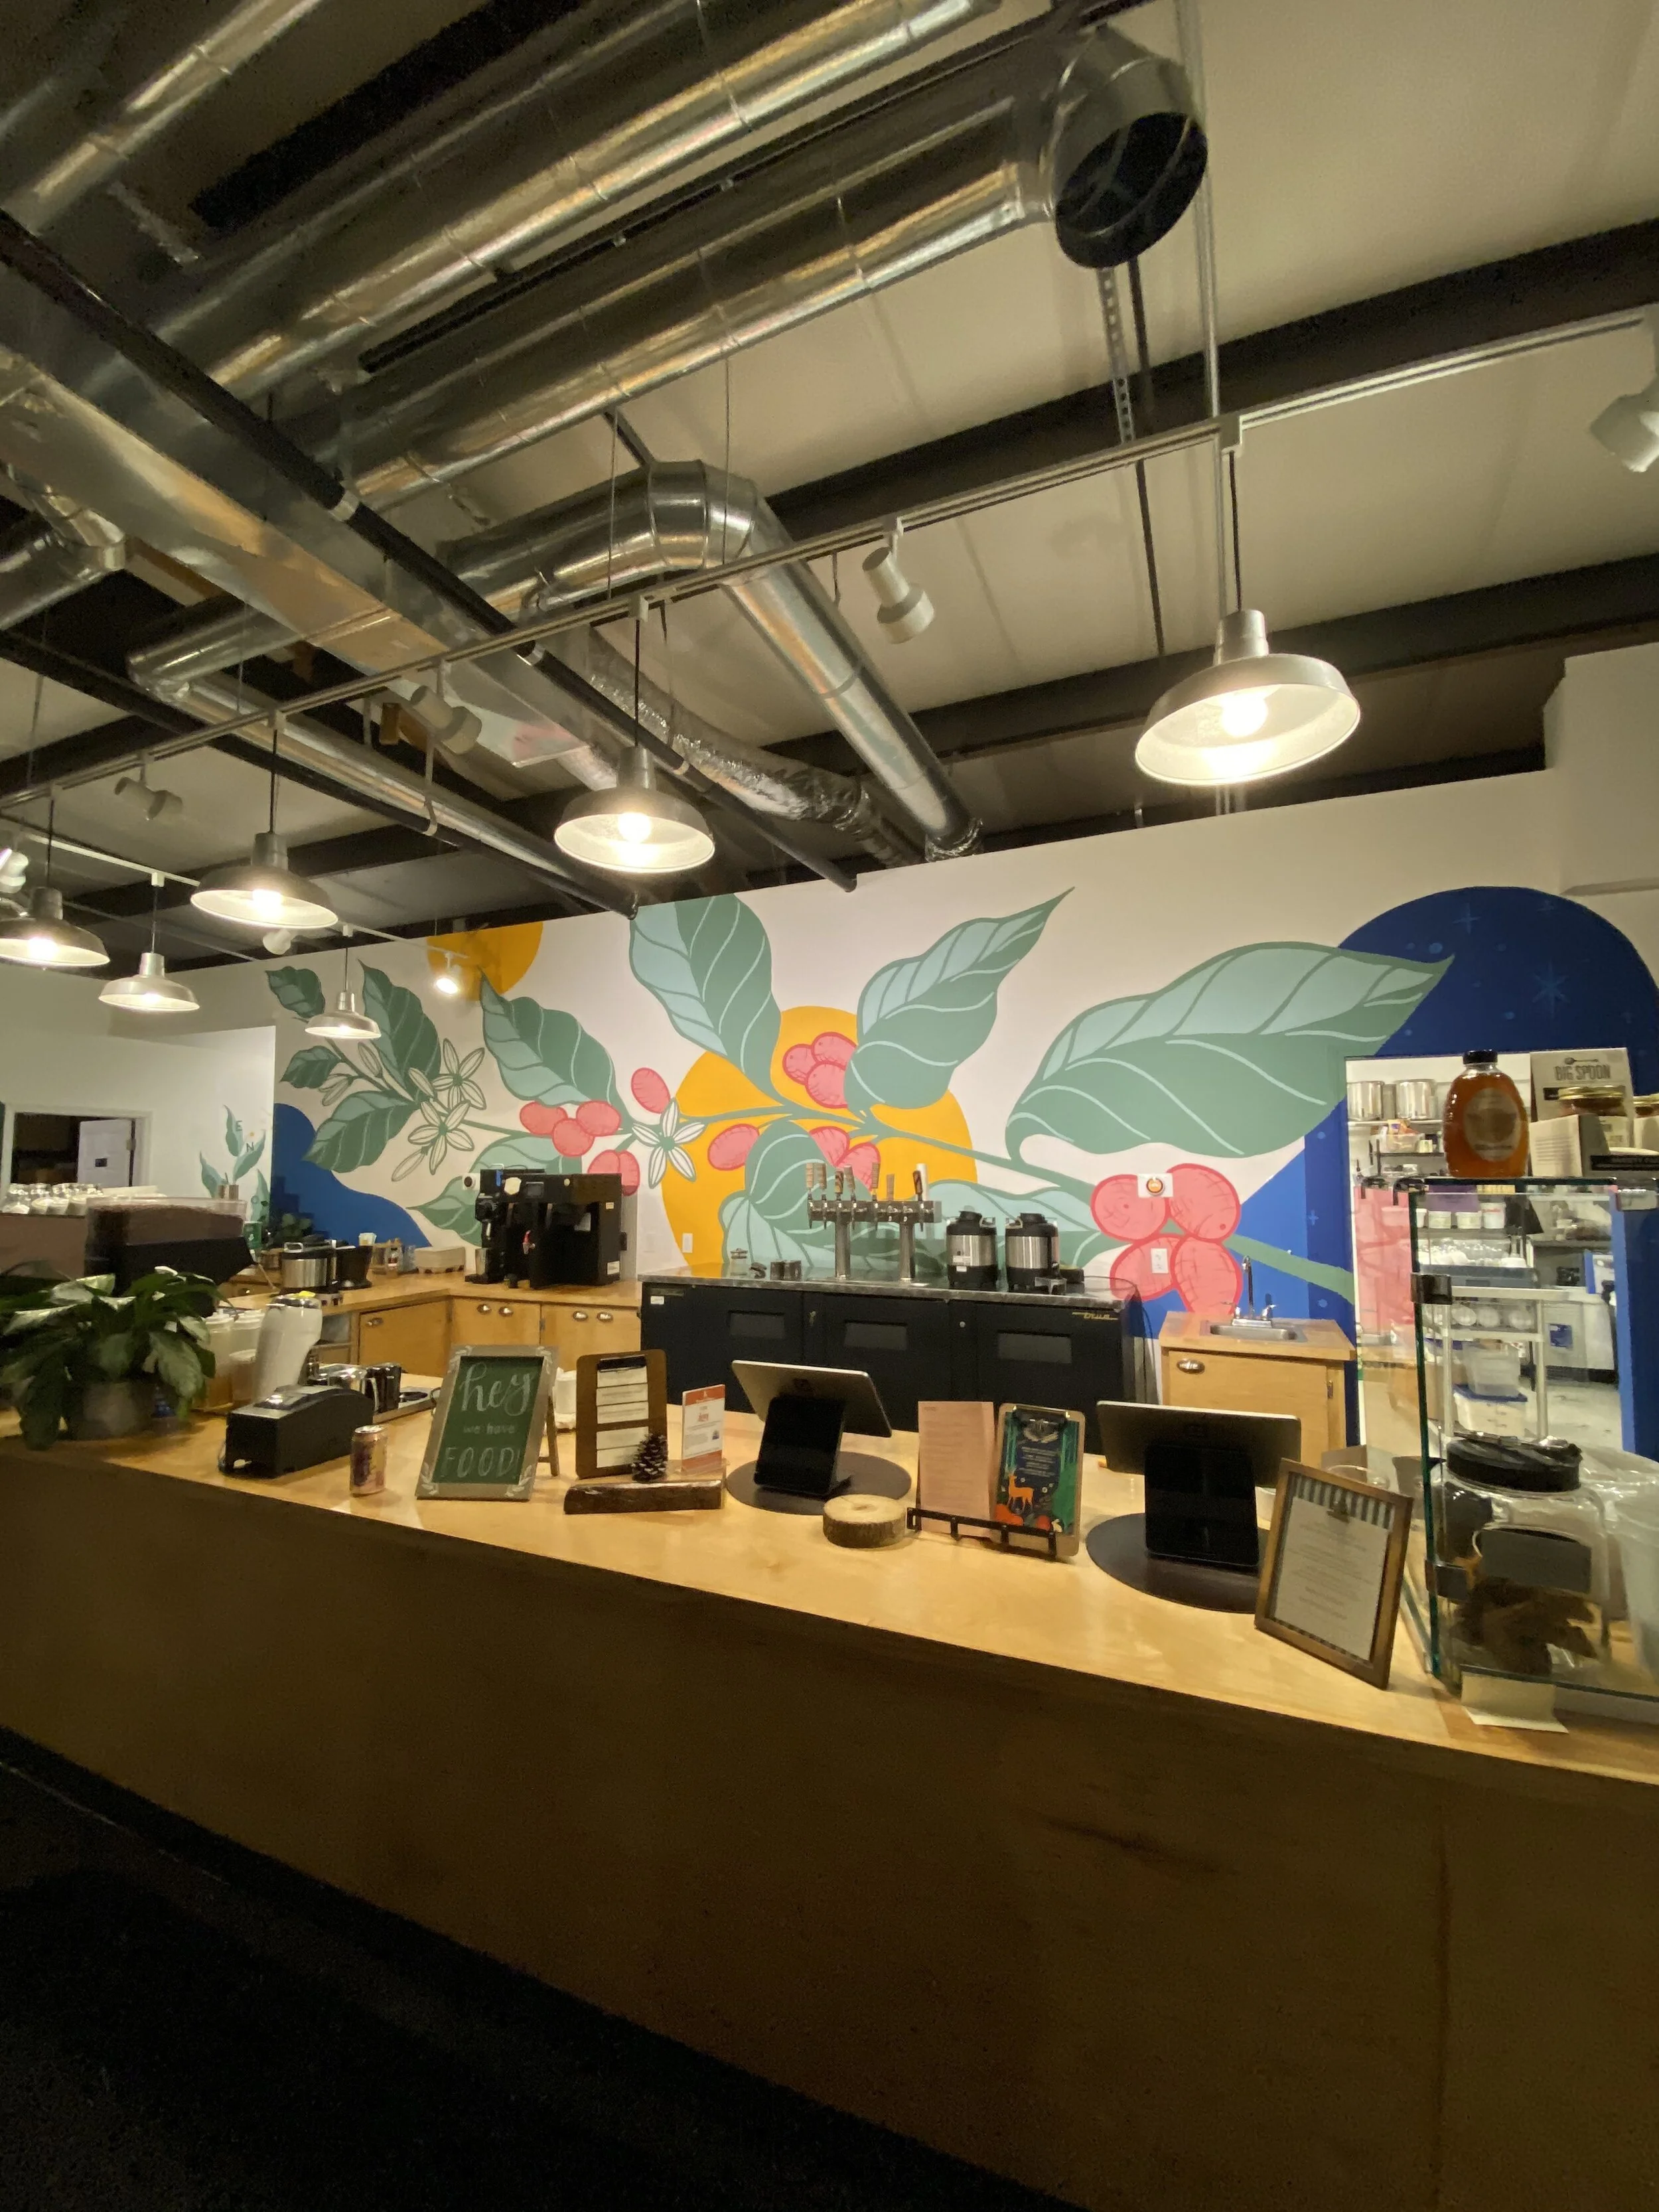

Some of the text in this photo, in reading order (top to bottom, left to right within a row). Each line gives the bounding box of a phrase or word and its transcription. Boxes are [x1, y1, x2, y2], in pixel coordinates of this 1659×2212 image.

[1555, 1065, 1611, 1080] BIG SPOON
[459, 1362, 532, 1416] hey
[463, 1422, 516, 1435] we have
